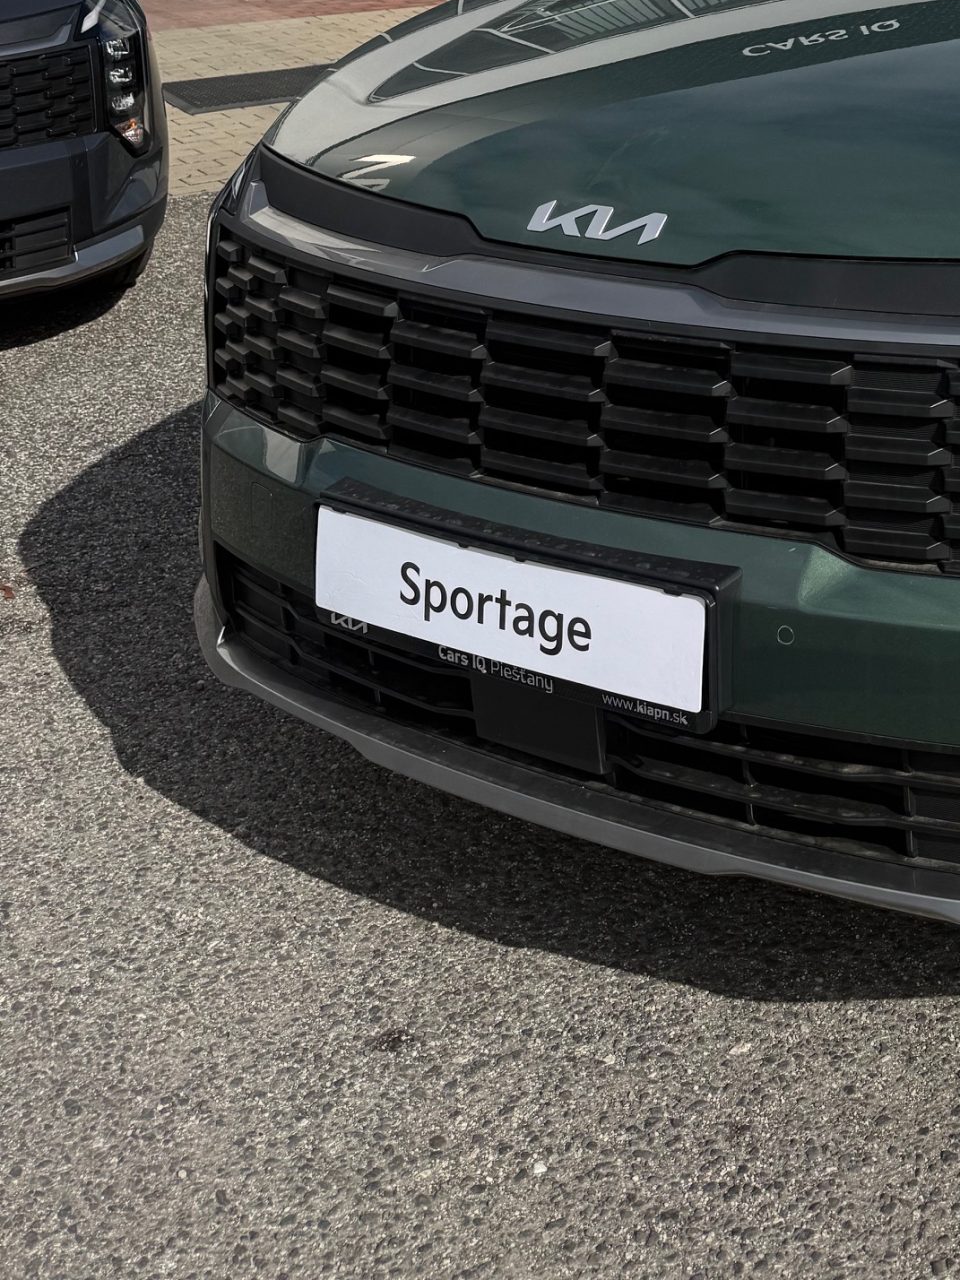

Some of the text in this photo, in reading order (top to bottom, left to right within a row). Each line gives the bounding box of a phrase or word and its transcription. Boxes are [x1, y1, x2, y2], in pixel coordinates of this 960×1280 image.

[526, 199, 668, 246] KIA
[399, 561, 592, 657] Sportage
[438, 644, 469, 667] Cars
[472, 655, 488, 674] IQ
[602, 693, 689, 726] www.kiapn.sk
